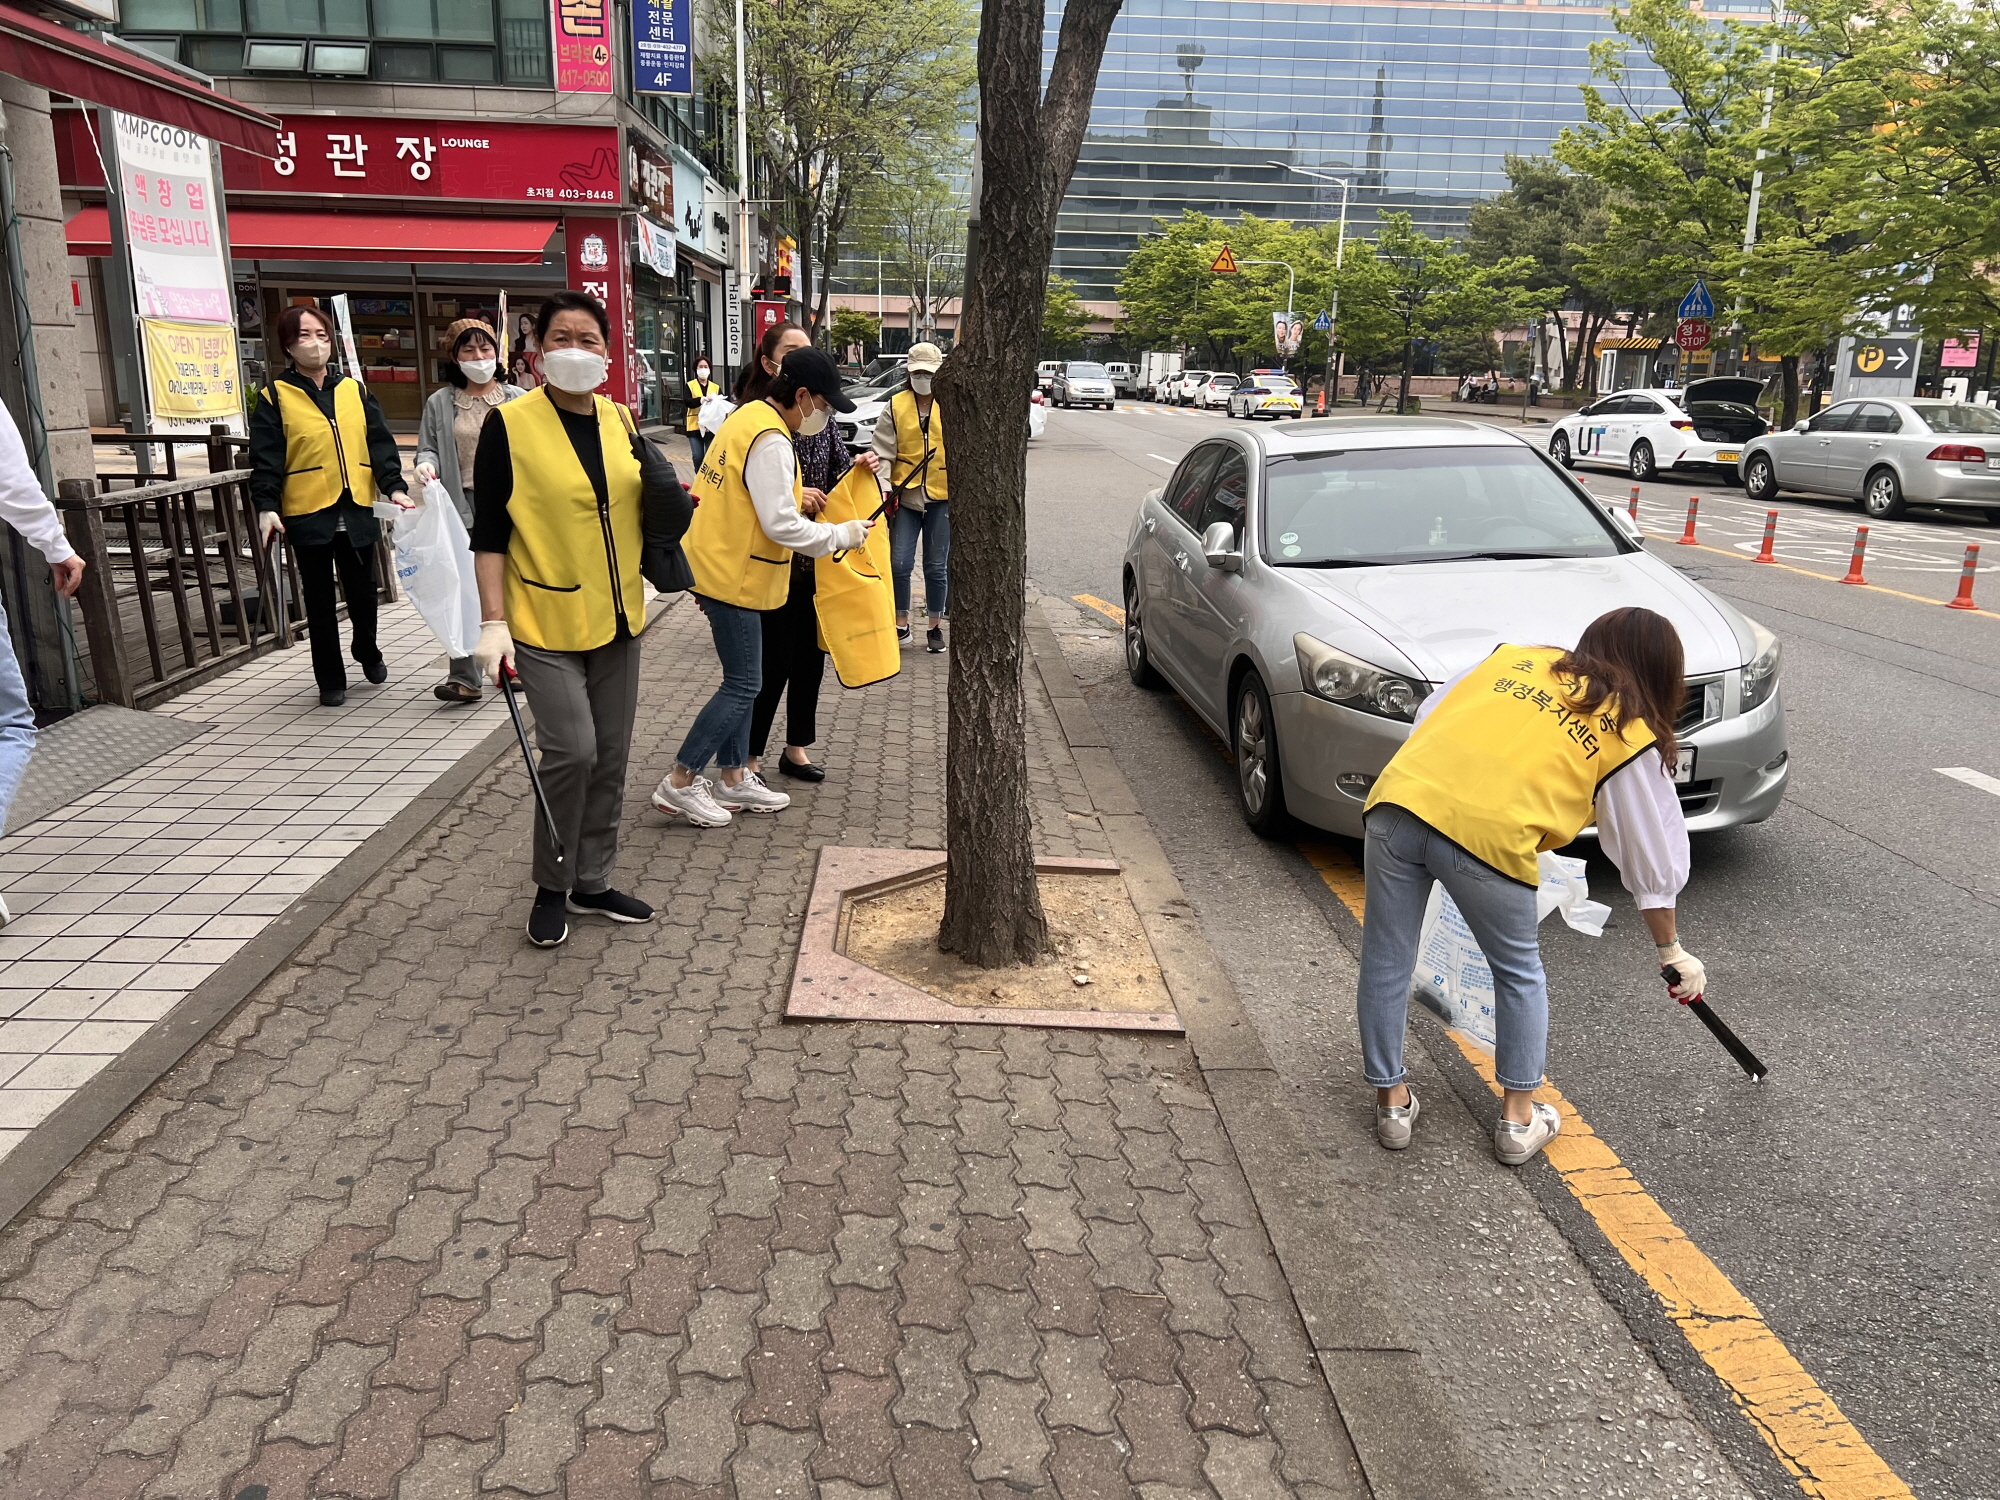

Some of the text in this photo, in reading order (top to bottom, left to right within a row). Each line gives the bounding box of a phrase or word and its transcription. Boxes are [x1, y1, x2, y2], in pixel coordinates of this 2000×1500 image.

[648, 10, 674, 26] 전문
[648, 27, 674, 41] 센터
[560, 44, 607, 64] 브라보 4F
[560, 69, 609, 87] 417-0500
[654, 72, 672, 87] 4F
[441, 138, 490, 149] LOUNGE
[526, 187, 614, 200] 초지점 403-8448
[158, 217, 210, 247] 모십니다
[727, 284, 742, 355] Hair Jadore
[625, 283, 636, 383] 정관장
[1681, 323, 1707, 336] 정지
[168, 334, 195, 355] OPEN
[1681, 336, 1706, 347] STOP
[1864, 347, 1880, 368] P
[1578, 426, 1607, 456] UT
[1493, 677, 1600, 761] 행정복지센터
